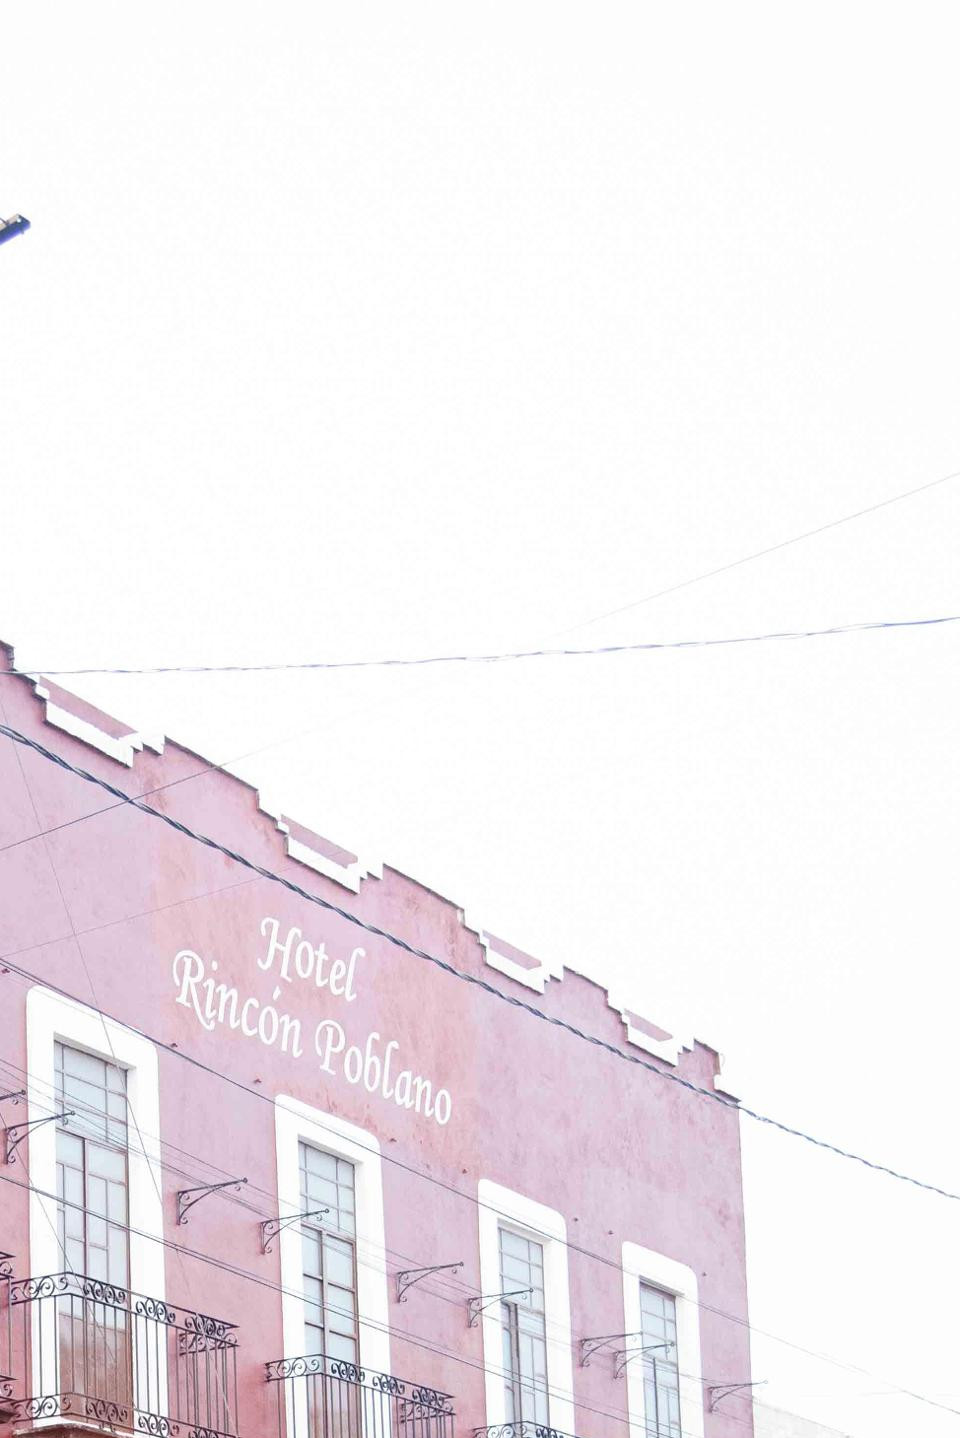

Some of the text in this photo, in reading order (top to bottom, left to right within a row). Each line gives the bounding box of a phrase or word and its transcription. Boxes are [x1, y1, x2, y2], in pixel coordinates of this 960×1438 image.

[257, 917, 366, 1002] Hotel
[172, 950, 452, 1125] Rincón Poblano
